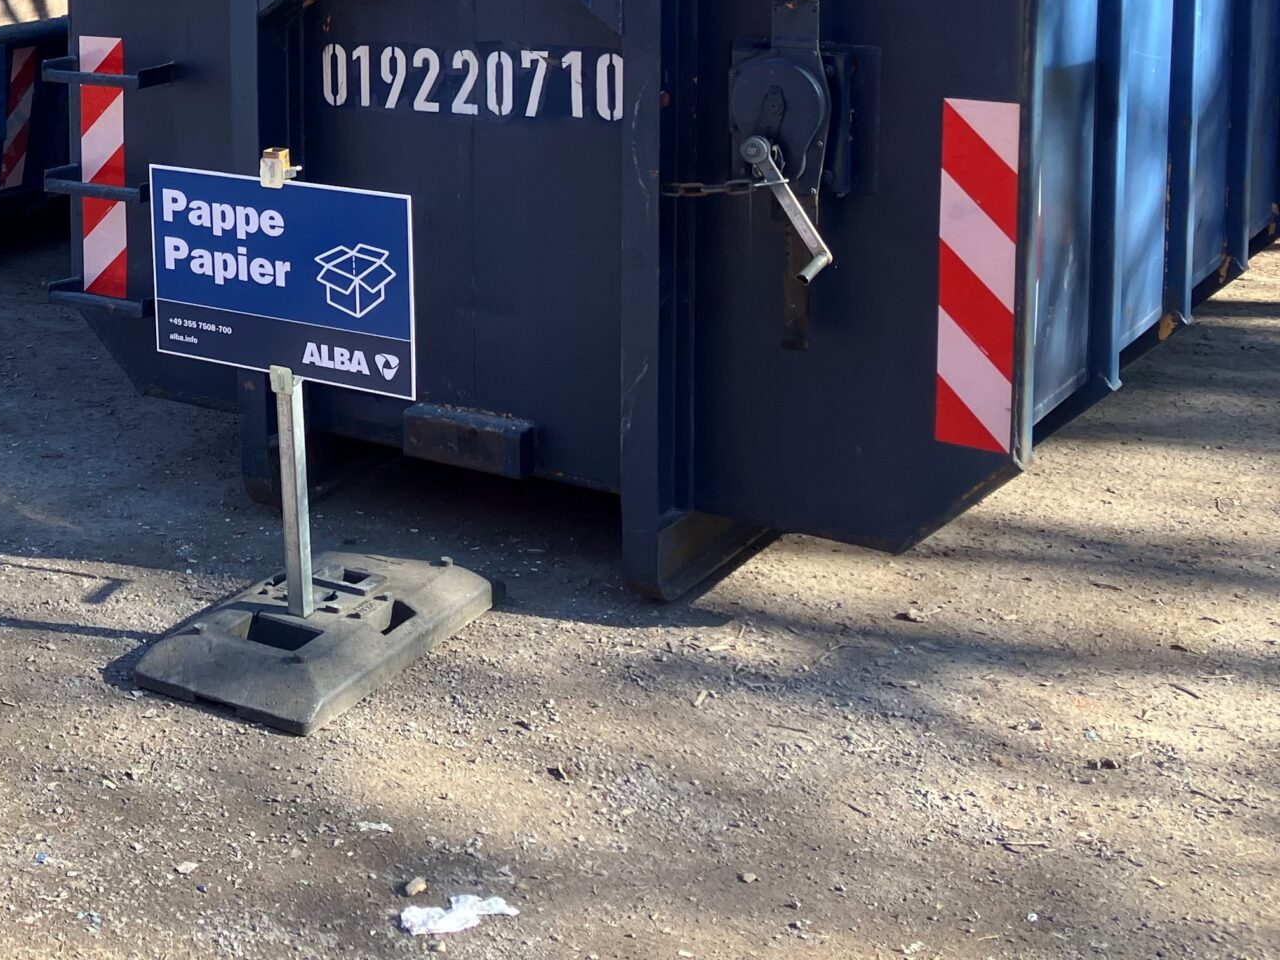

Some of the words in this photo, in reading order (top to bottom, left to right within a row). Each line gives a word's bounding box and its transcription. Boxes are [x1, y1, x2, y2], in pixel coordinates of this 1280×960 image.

[322, 43, 624, 122] 019220710
[161, 188, 285, 240] Pappe
[163, 236, 291, 288] Papier
[169, 317, 182, 326] +49
[183, 319, 197, 329] 355
[198, 321, 233, 335] 7508-700
[169, 333, 199, 344] alba.info
[302, 342, 370, 376] ALBA
